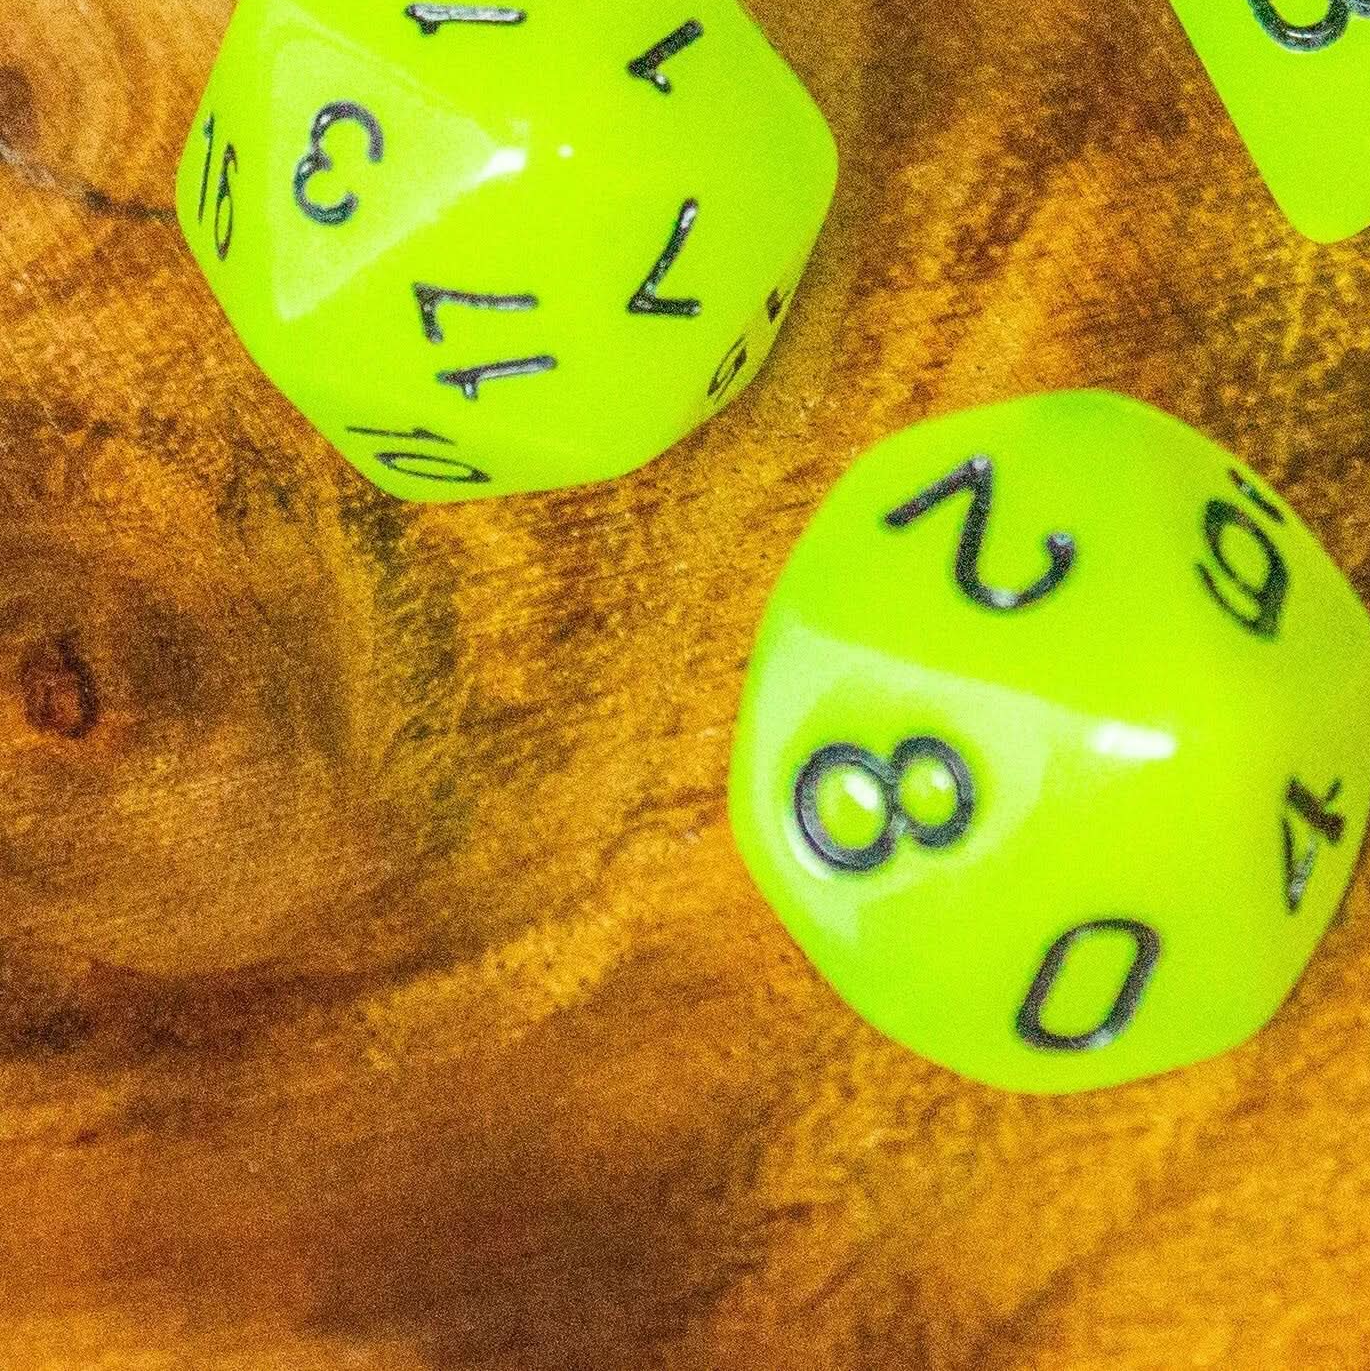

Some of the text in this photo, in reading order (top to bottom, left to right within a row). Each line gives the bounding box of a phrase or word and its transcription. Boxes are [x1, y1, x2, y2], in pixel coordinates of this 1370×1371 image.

[625, 18, 705, 96] 1
[292, 100, 385, 227] 3
[625, 196, 702, 320] 7
[412, 282, 559, 401] 17
[882, 457, 1079, 614] 2
[791, 733, 978, 877] 8
[1280, 777, 1347, 916] 4
[1013, 916, 1164, 1054] 0
